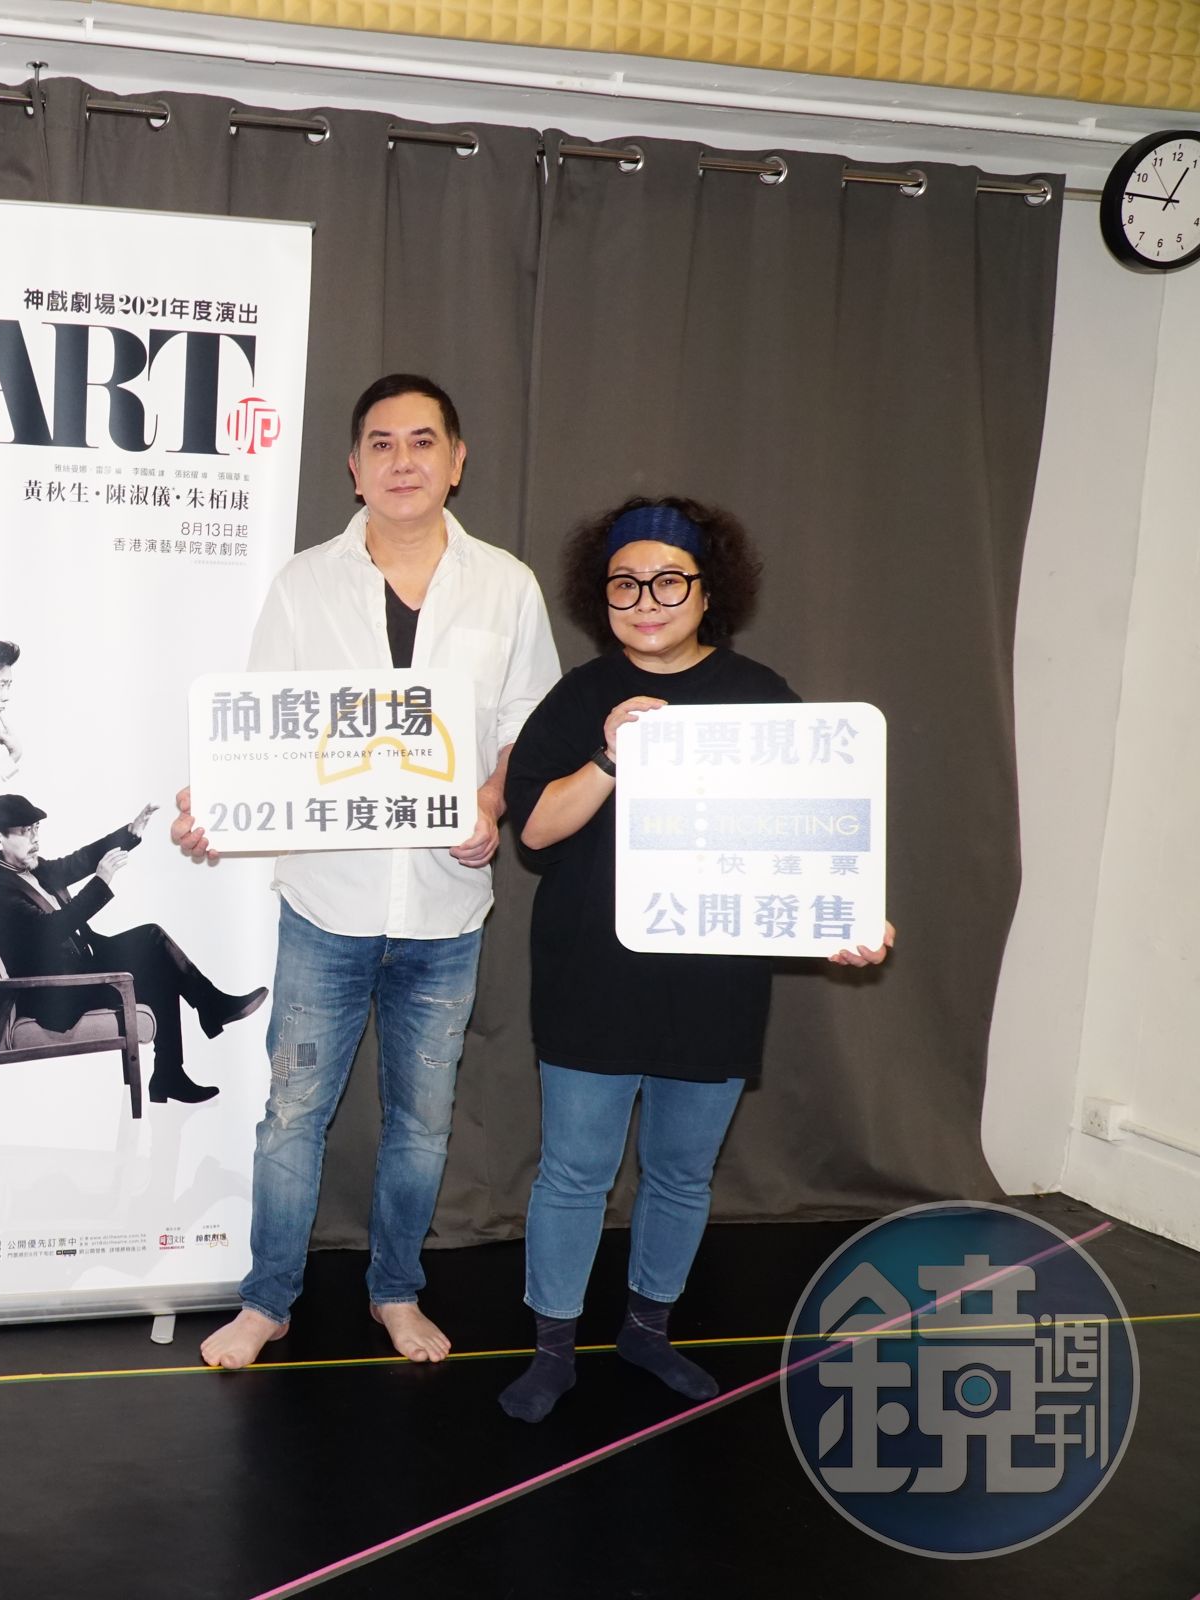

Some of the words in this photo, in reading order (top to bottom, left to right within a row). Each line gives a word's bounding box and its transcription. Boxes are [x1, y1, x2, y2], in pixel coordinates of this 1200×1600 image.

[1153, 157, 1164, 167] 11
[1172, 152, 1184, 162] 12
[1193, 160, 1198, 169] 1
[1136, 173, 1148, 183] 10
[1127, 215, 1134, 224] 8
[1138, 232, 1145, 241] 7
[1176, 234, 1182, 243] 5
[1157, 238, 1164, 248] 6
[23, 288, 258, 325] 神戲劇場2021年度演出
[181, 521, 248, 538] 8月13日起
[113, 537, 248, 557] 香港演藝學院歌劇院
[208, 686, 433, 742] 神戲劇場
[640, 718, 859, 767] 門票現於
[212, 752, 270, 762] DIONYSUS
[282, 750, 373, 761] CONTEMPORARY
[386, 748, 433, 758] THEATRE
[208, 794, 459, 833] 2021年度演出
[644, 892, 856, 940] 公開發售
